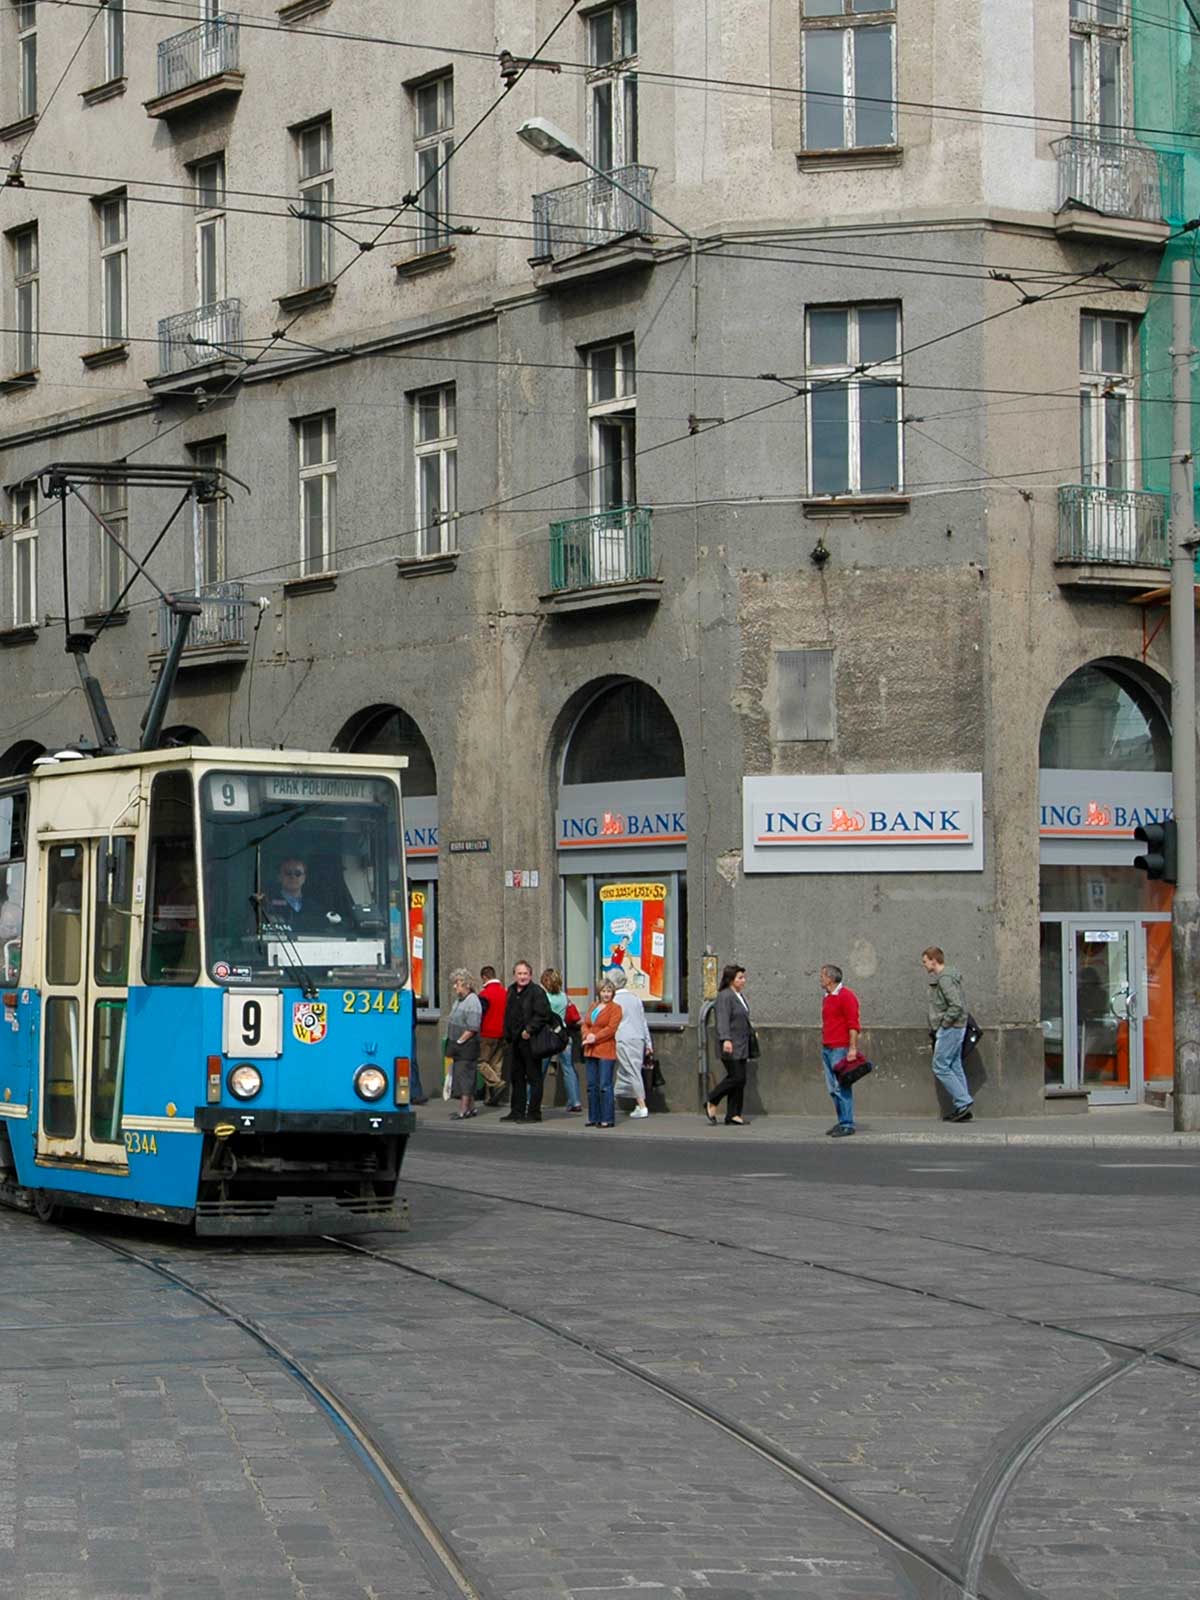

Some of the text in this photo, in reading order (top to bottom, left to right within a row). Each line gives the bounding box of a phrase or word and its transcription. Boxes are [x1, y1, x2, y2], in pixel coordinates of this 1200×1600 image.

[222, 783, 235, 806] 9
[273, 779, 298, 794] PARK
[563, 813, 685, 837] ING BANK
[765, 810, 960, 833] ING BANK
[1040, 806, 1173, 827] ING BANK
[404, 828, 438, 846] ANK
[343, 991, 400, 1013] 2344
[242, 1000, 262, 1046] 9
[124, 1132, 158, 1154] 2344
